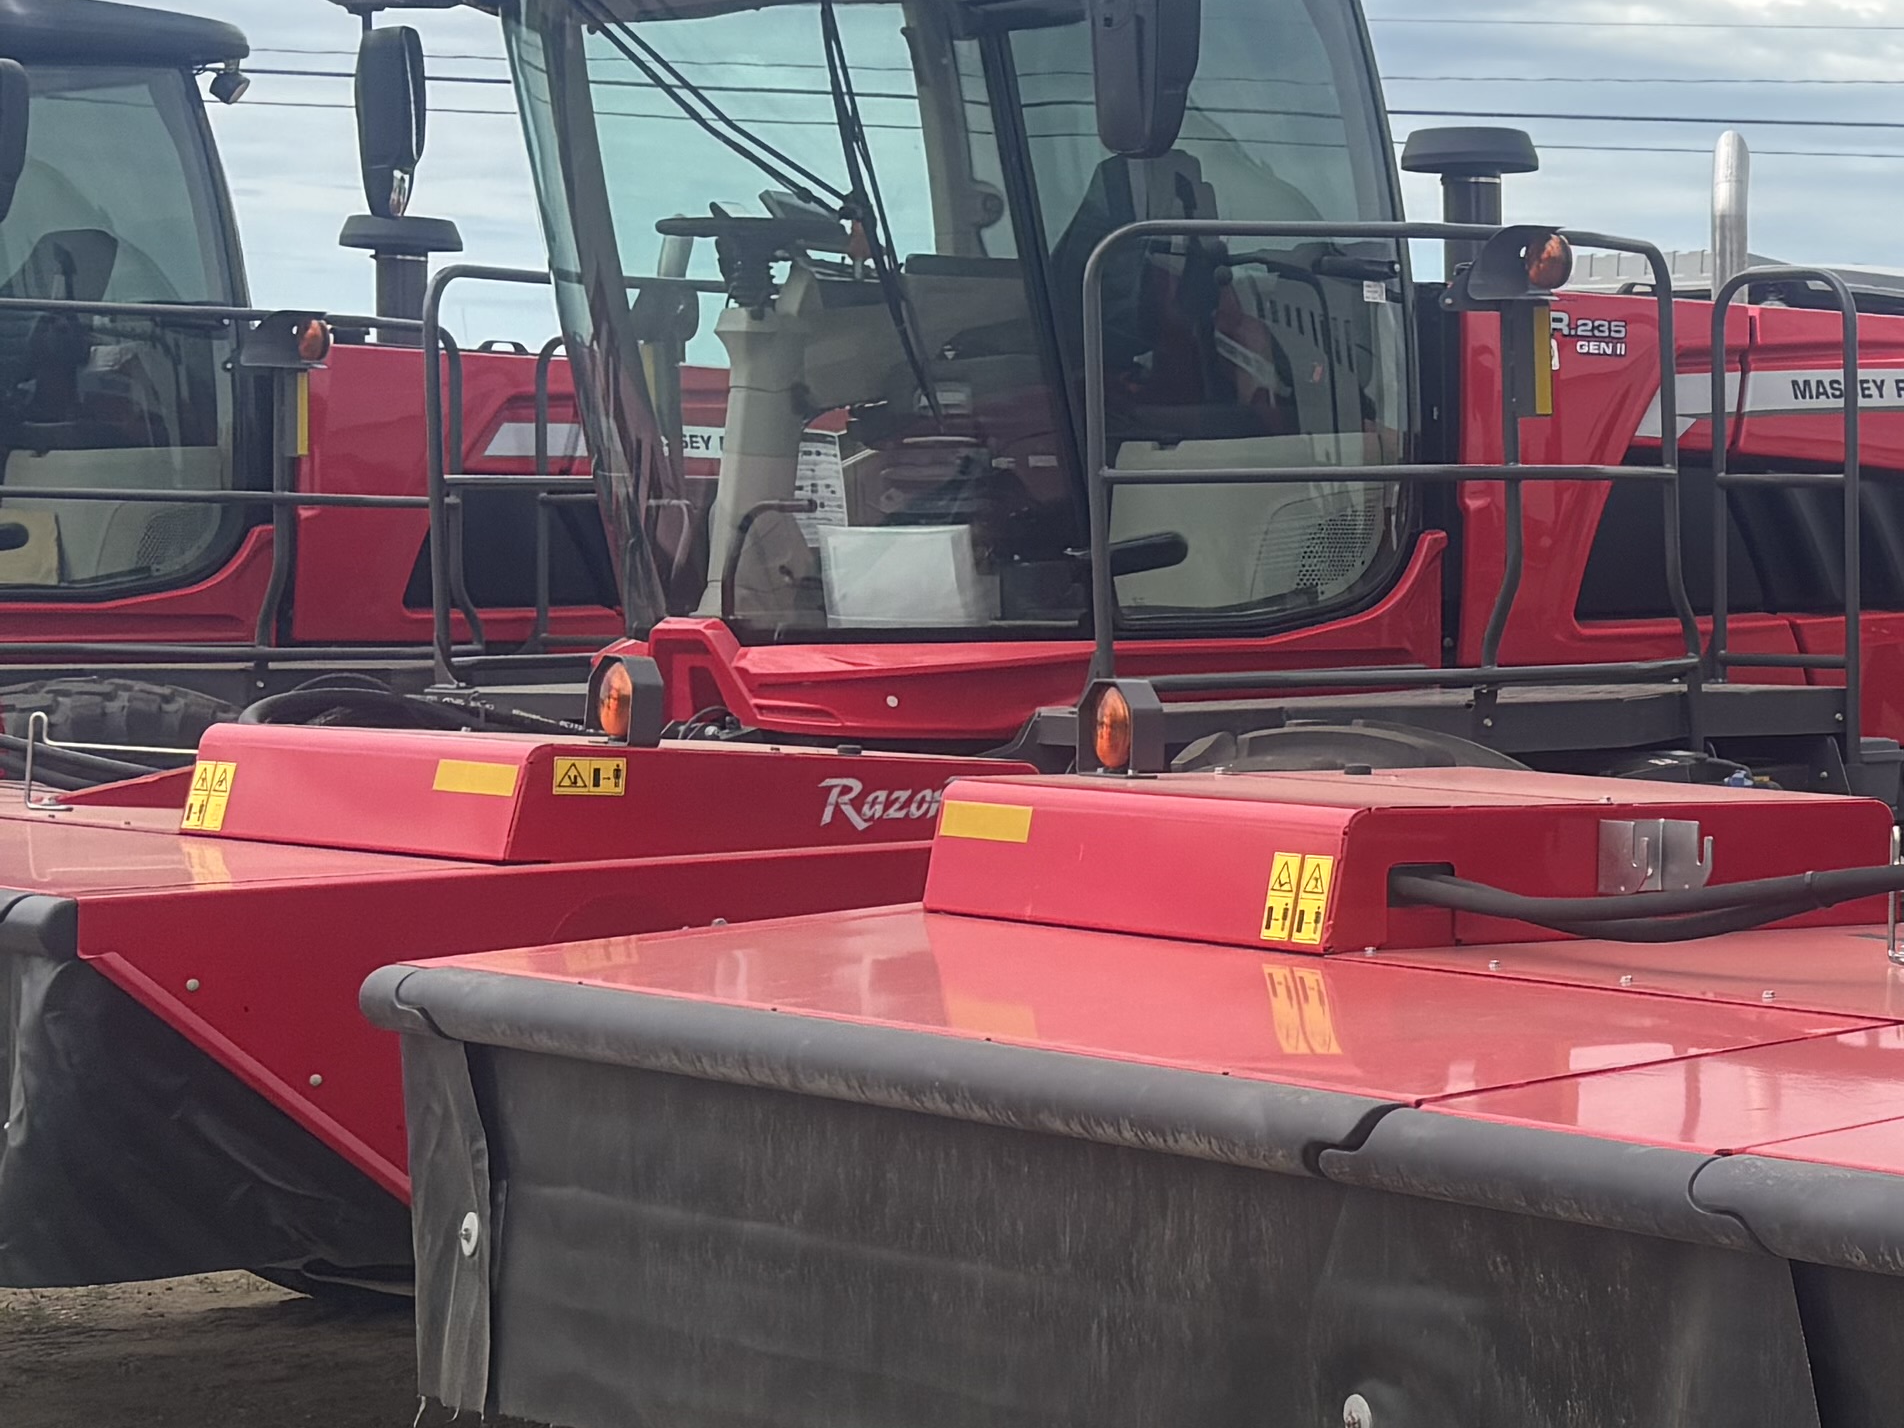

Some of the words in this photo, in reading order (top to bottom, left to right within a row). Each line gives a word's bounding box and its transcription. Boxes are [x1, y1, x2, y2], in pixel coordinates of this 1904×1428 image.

[1576, 340, 1613, 356] GEN
[1616, 342, 1626, 356] II
[1791, 378, 1886, 401] MASEY
[817, 775, 958, 831] Razor
